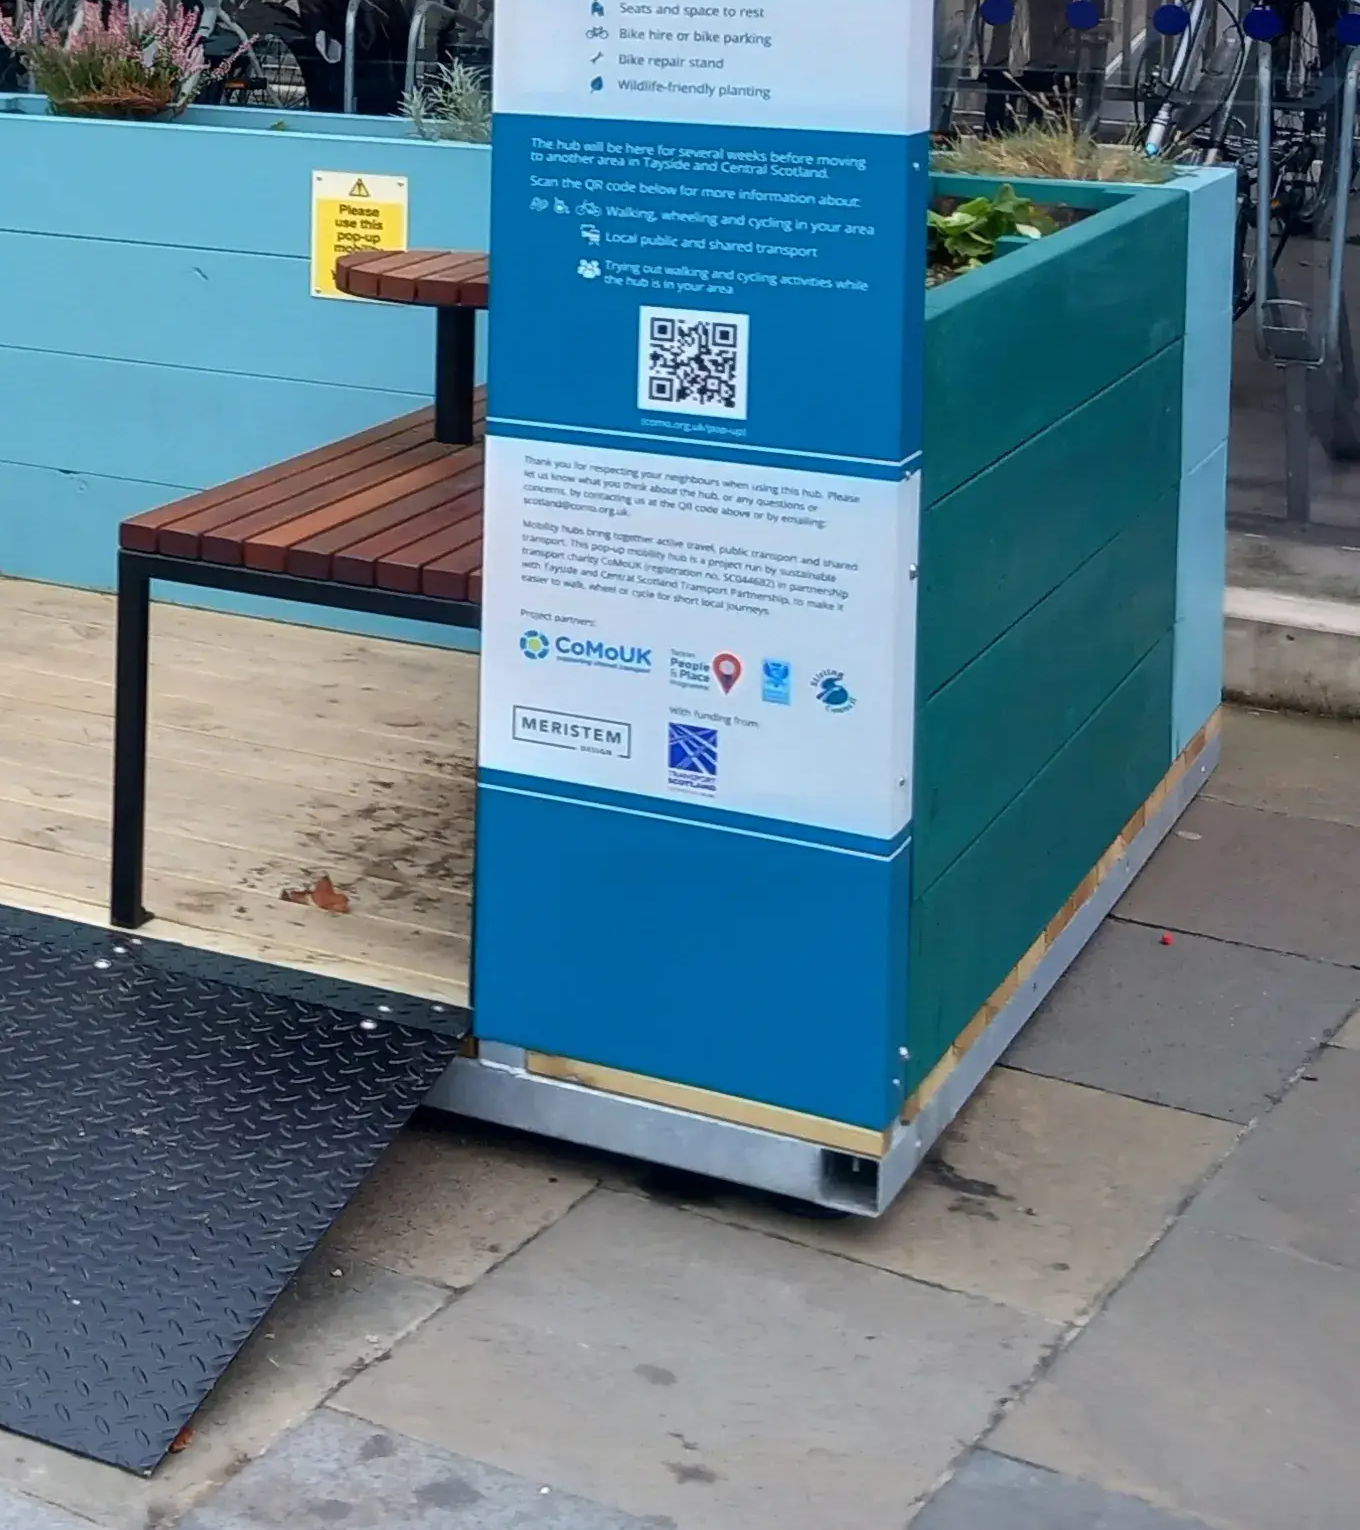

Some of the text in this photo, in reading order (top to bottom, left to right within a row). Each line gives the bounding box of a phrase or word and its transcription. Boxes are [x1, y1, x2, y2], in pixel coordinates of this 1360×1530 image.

[620, 2, 764, 19] Seats and space to rest
[619, 27, 772, 48] Bike hire or bike parking
[618, 54, 724, 71] Bike repair stand
[618, 80, 771, 100] Wildlife-friendly planting
[530, 152, 543, 162] to
[546, 153, 594, 165] another
[597, 157, 625, 167] area
[628, 156, 640, 167] in
[643, 157, 690, 172] Tayside
[692, 161, 717, 172] and
[720, 162, 767, 175] Central
[532, 137, 867, 170] The hub will be here for several weeks before moving
[530, 176, 559, 188] Scan
[561, 178, 582, 189] the
[584, 179, 603, 192] QR
[605, 181, 636, 193] code
[639, 183, 677, 195] below
[679, 185, 698, 197] for
[700, 189, 735, 199] more
[738, 189, 815, 204] information
[338, 203, 380, 217] Please
[335, 219, 383, 230] use this
[660, 211, 717, 227] wheeling
[720, 215, 745, 226] and
[748, 218, 792, 232] cycling
[795, 219, 807, 231] in
[810, 223, 841, 234] your
[844, 225, 875, 235] area
[336, 232, 381, 244] pop-up
[605, 232, 818, 259] Local public and shared transport
[604, 274, 733, 294] the hub is in your area
[605, 260, 868, 291] Trying out walking and cycling activities while
[524, 455, 552, 467] Thank
[553, 461, 571, 470] you
[573, 461, 587, 471] for
[589, 465, 639, 479] respecting
[640, 471, 662, 480] your
[664, 473, 720, 486] neighbours
[721, 479, 749, 490] when
[751, 483, 778, 495] using
[780, 485, 799, 496] this
[826, 490, 860, 503] Please
[524, 469, 535, 478] let
[537, 472, 548, 480] us
[550, 472, 575, 483] know
[577, 476, 601, 486] what
[602, 480, 620, 489] you
[622, 481, 647, 491] think
[648, 484, 677, 495] about
[679, 487, 696, 497] the
[721, 494, 733, 502] or
[735, 495, 753, 506] any
[755, 498, 805, 510] questions
[806, 504, 818, 512] or
[555, 636, 652, 667] CoMoUK
[670, 658, 710, 672] People
[680, 670, 710, 683] Place
[521, 717, 622, 745] MERISTEM
[668, 777, 717, 792] SCOTLAND
